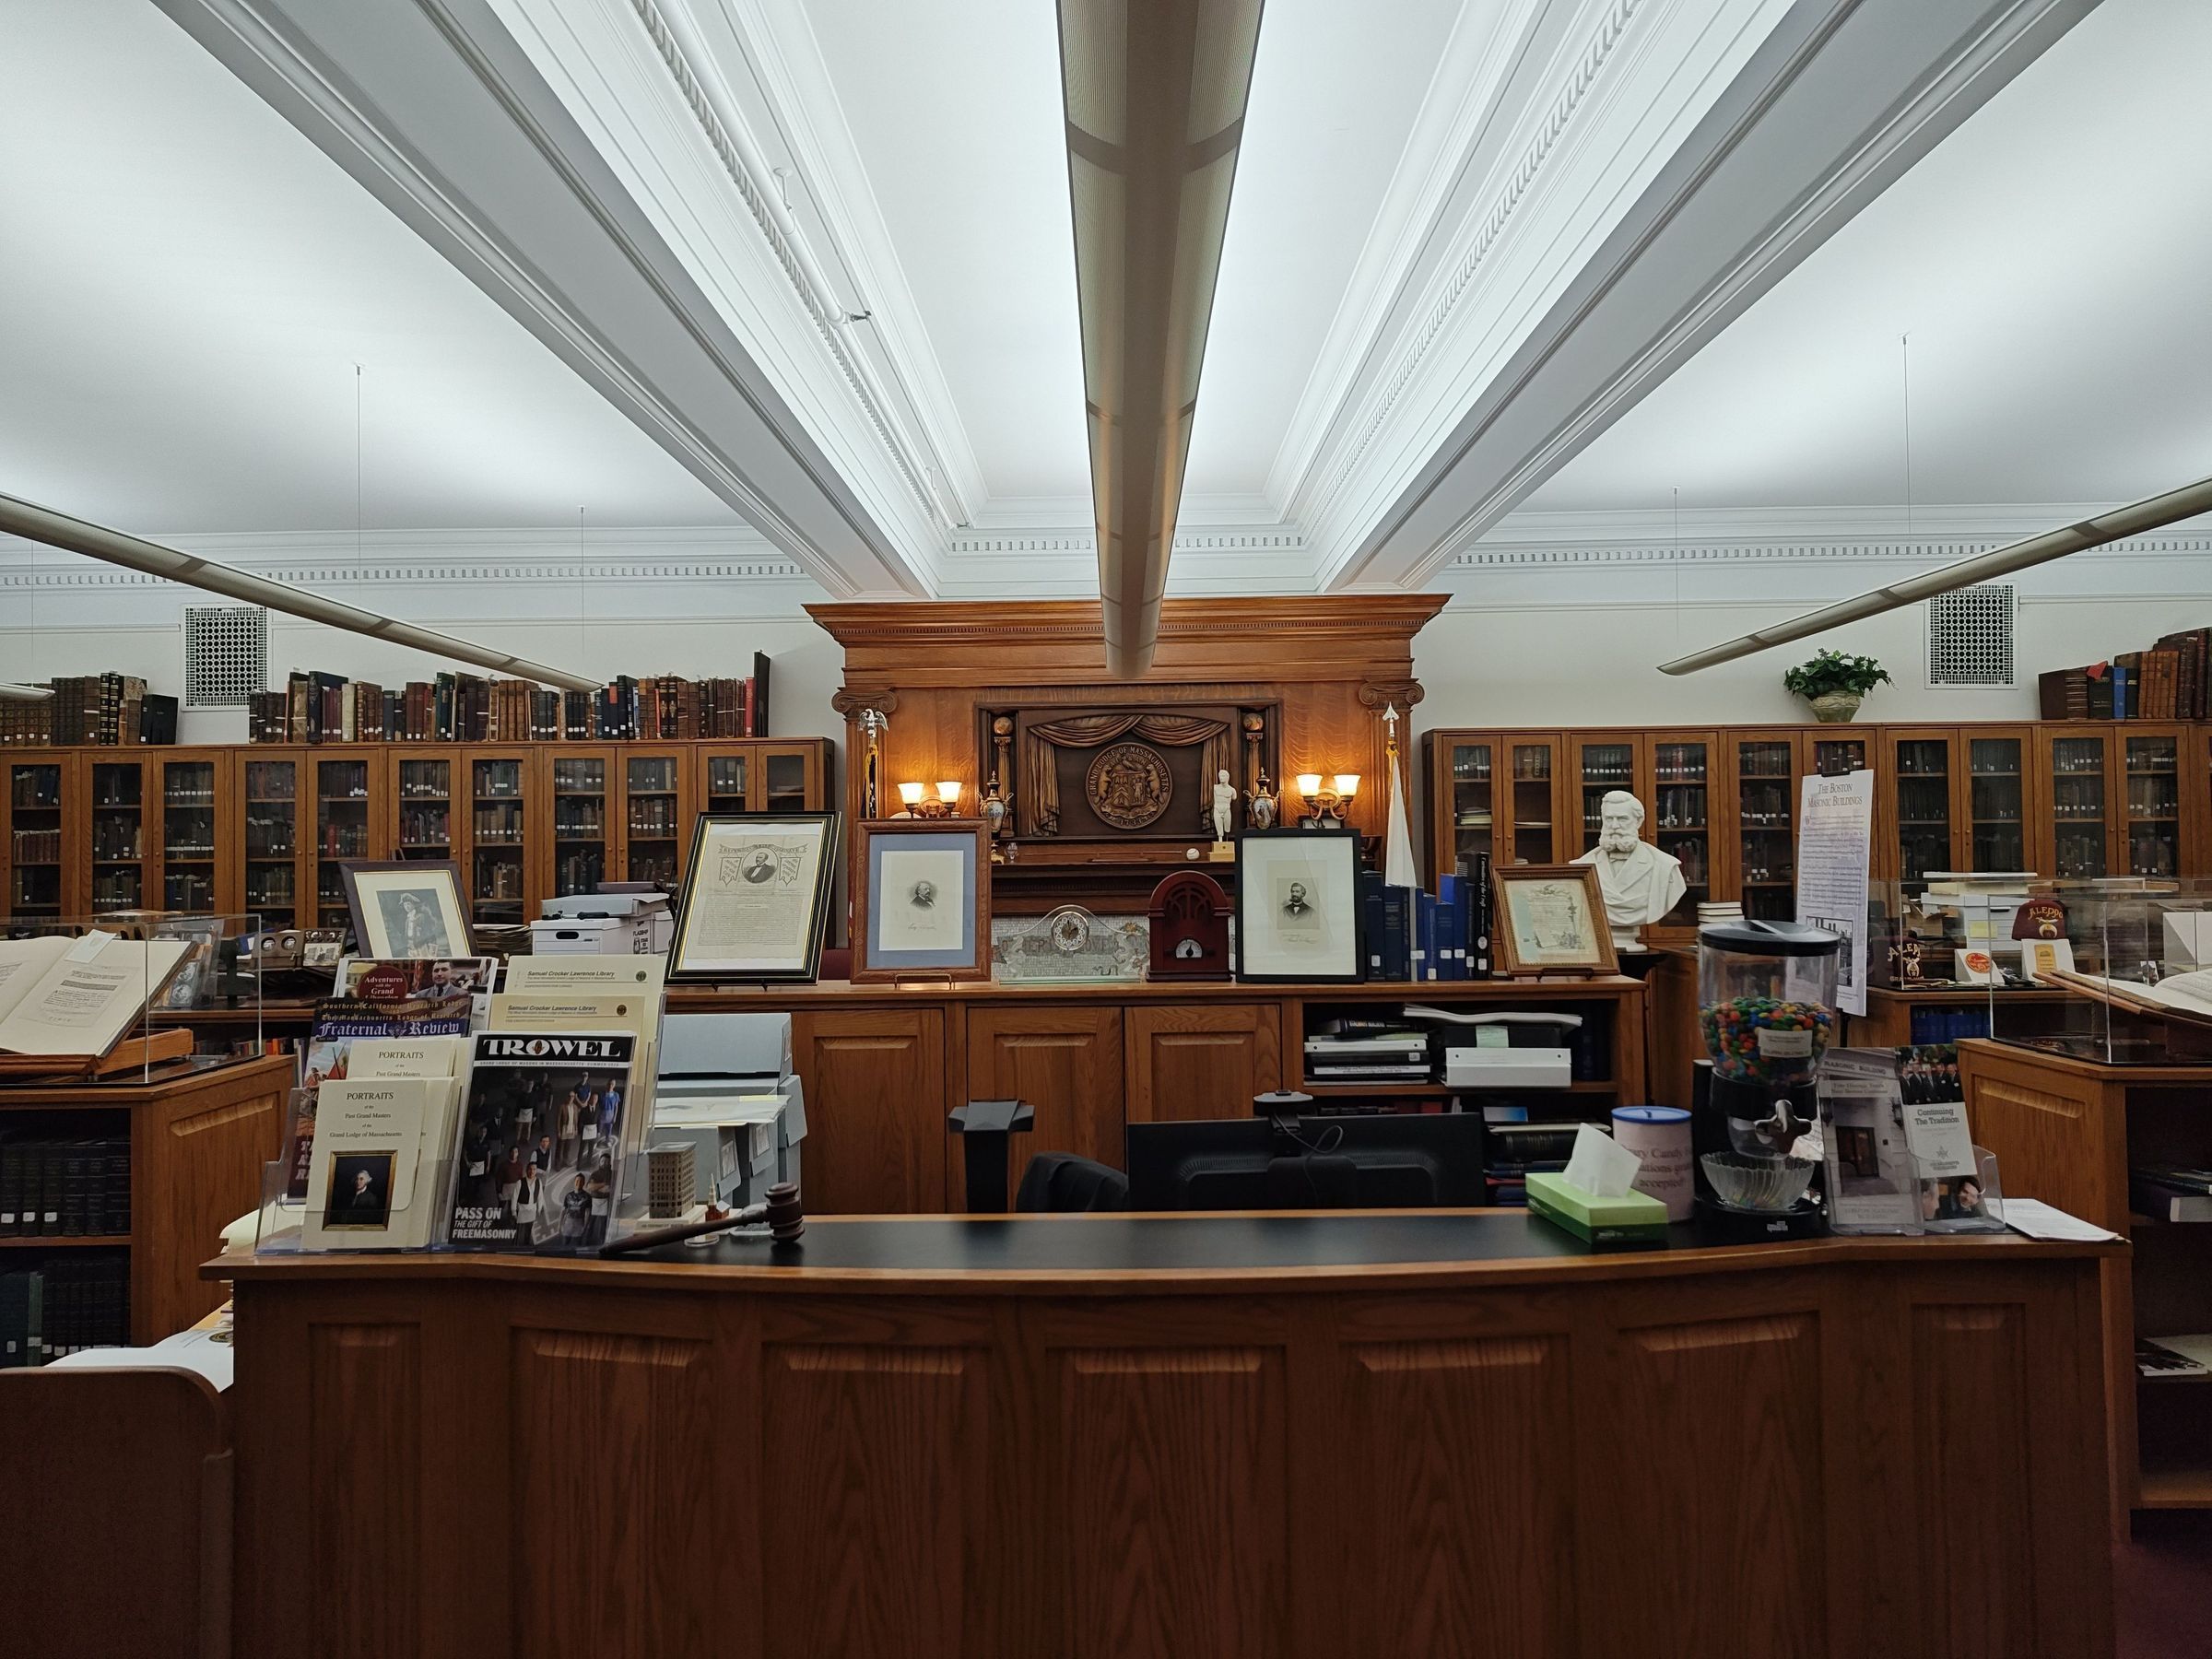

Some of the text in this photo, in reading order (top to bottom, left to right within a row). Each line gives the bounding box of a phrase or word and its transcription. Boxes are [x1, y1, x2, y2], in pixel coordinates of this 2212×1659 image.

[1090, 769, 1100, 795] GRAND
[1098, 749, 1116, 769] LODGE
[1130, 746, 1170, 793] MASSACHUSETTS
[1818, 782, 1853, 794] THE BOSTON
[1807, 795, 1863, 808] MASONIC BUILDINGS
[2029, 906, 2064, 920] ALEPPO
[1888, 943, 1921, 962] ALEP
[323, 1002, 359, 1010] Southern
[363, 1002, 402, 1010] California
[315, 1021, 460, 1037] Fraternal Review
[482, 1039, 621, 1057] TROWEL
[378, 1051, 424, 1059] PORTRAITS
[347, 1092, 394, 1100] PORTRAITS
[1917, 1109, 1954, 1117] Continuing
[1929, 1117, 1959, 1125] Tradition
[1638, 1164, 1673, 1173] ations
[454, 1206, 502, 1220] PASS ON
[453, 1219, 493, 1229] THE GIFT OF
[452, 1229, 517, 1239] FREEMASONRY
